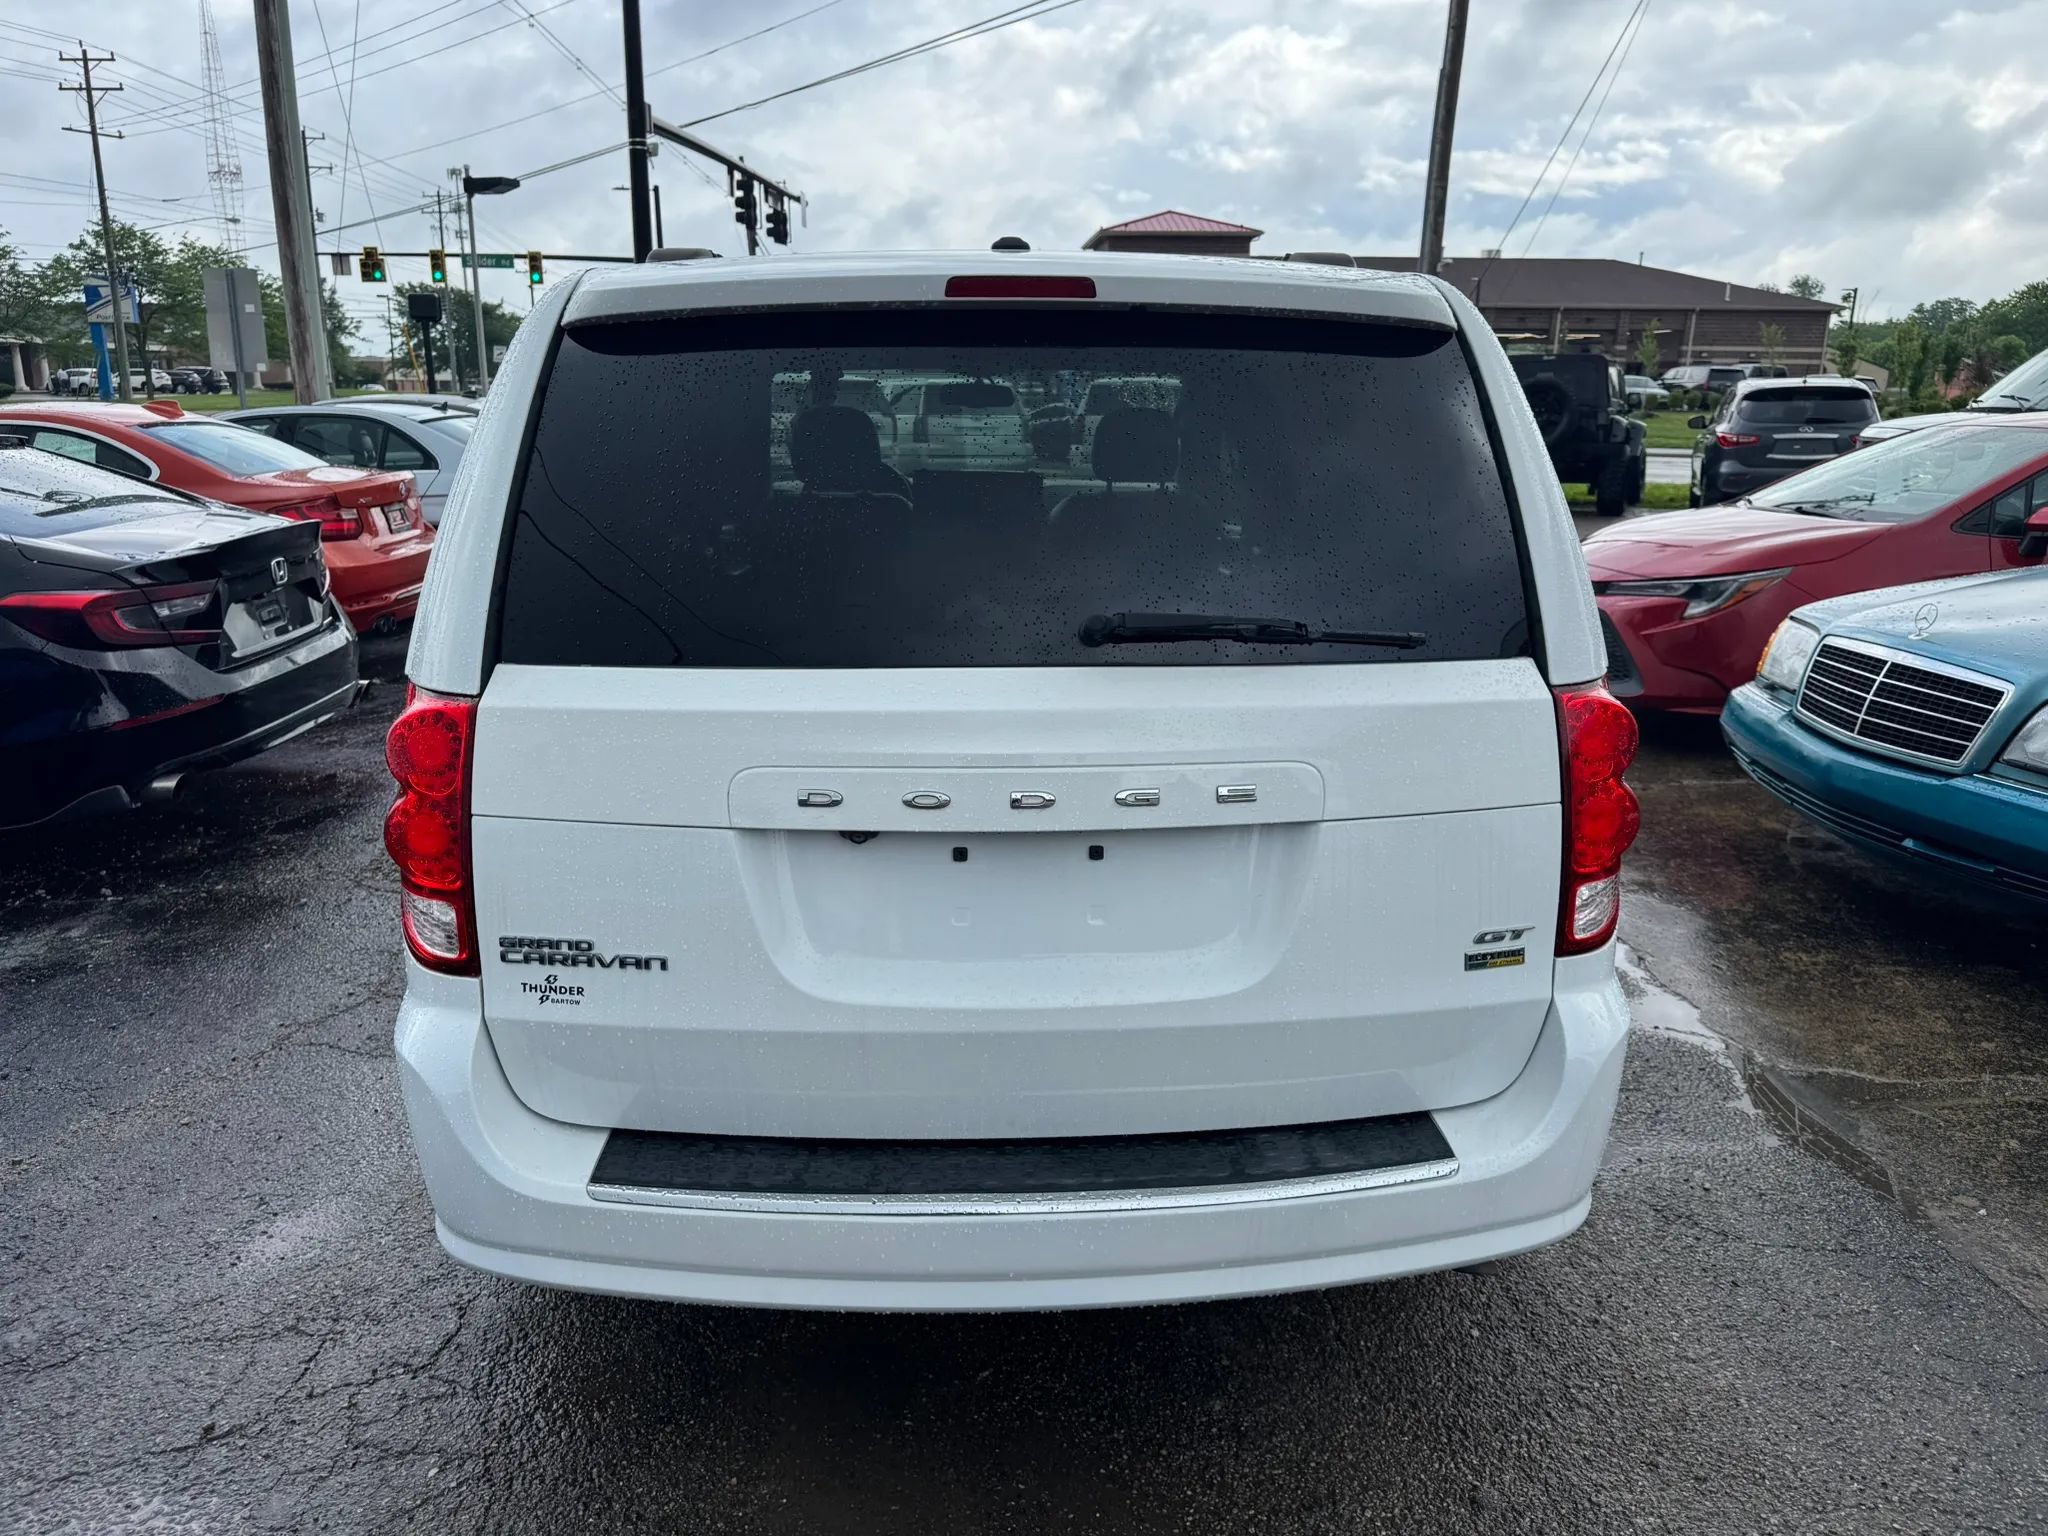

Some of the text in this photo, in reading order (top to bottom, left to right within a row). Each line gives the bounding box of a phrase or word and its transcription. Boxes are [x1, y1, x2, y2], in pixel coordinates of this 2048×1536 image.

[797, 784, 1257, 808] DODGE
[1473, 923, 1536, 945] GT
[499, 936, 594, 951] GRAND
[500, 949, 669, 971] CARAVAN
[520, 982, 585, 997] THUNDER
[550, 997, 581, 1006] BARTOW
